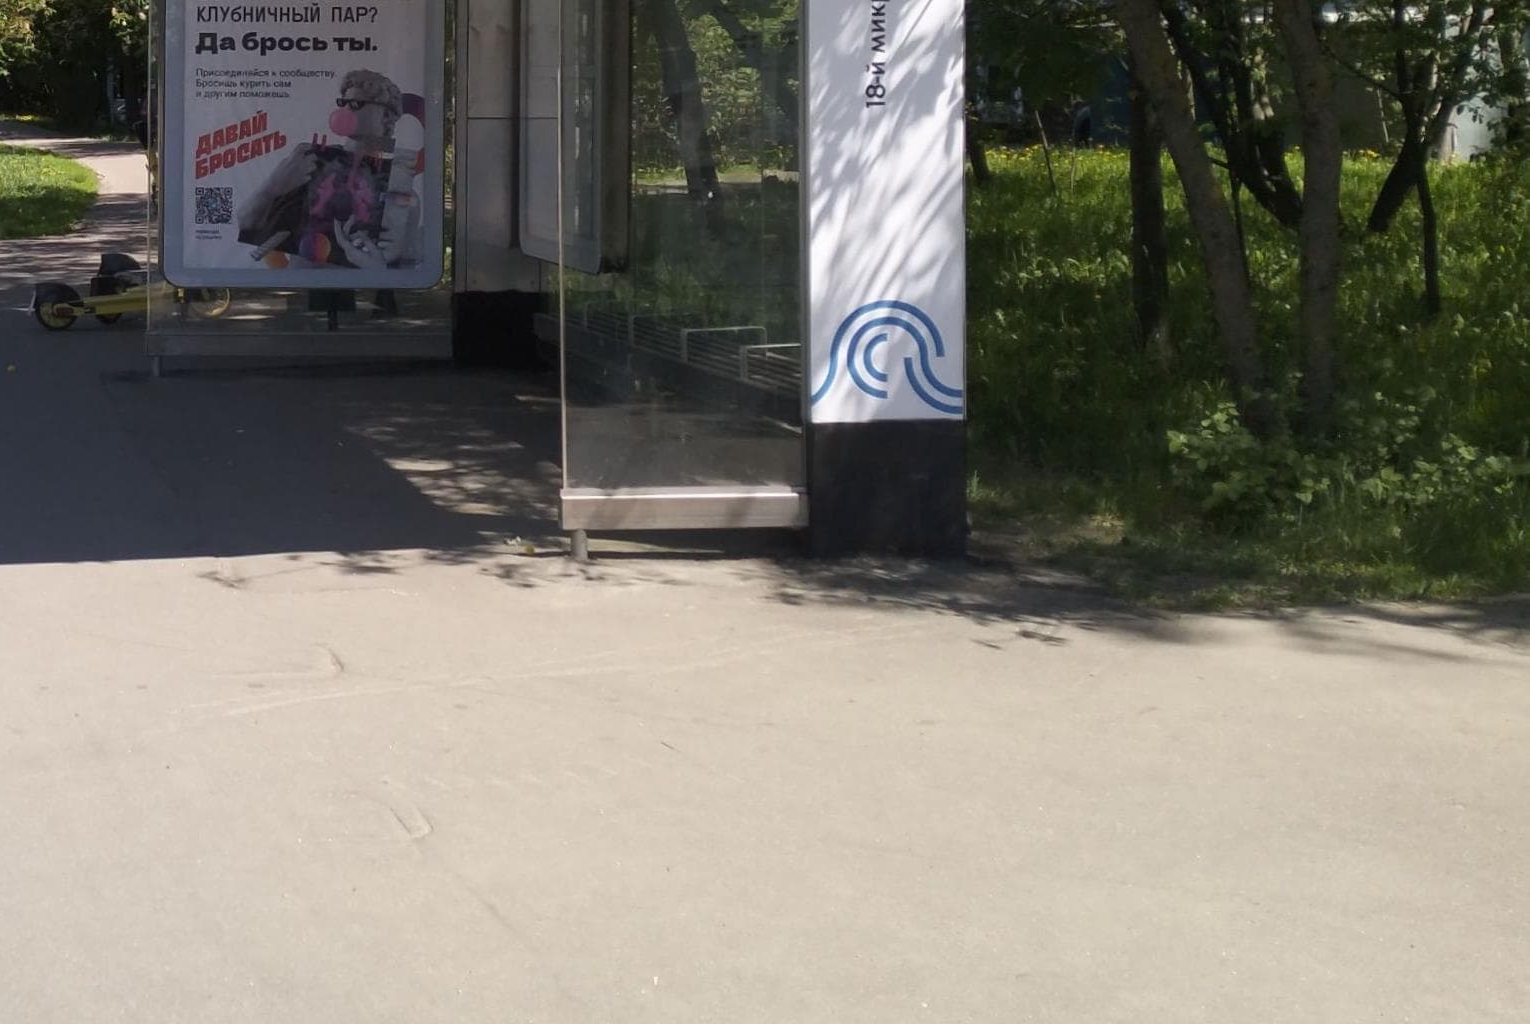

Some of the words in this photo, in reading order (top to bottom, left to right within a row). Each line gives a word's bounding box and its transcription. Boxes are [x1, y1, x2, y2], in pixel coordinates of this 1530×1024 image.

[331, 6, 378, 23] ПАР?
[195, 32, 237, 55] Да
[241, 32, 328, 56] брось
[333, 36, 378, 52] ты.
[239, 80, 271, 89] курить
[273, 80, 292, 88] сам
[866, 62, 887, 109] 18-й
[196, 109, 268, 159] ДАВАЙ
[195, 130, 287, 180] БРОСАТЬ
